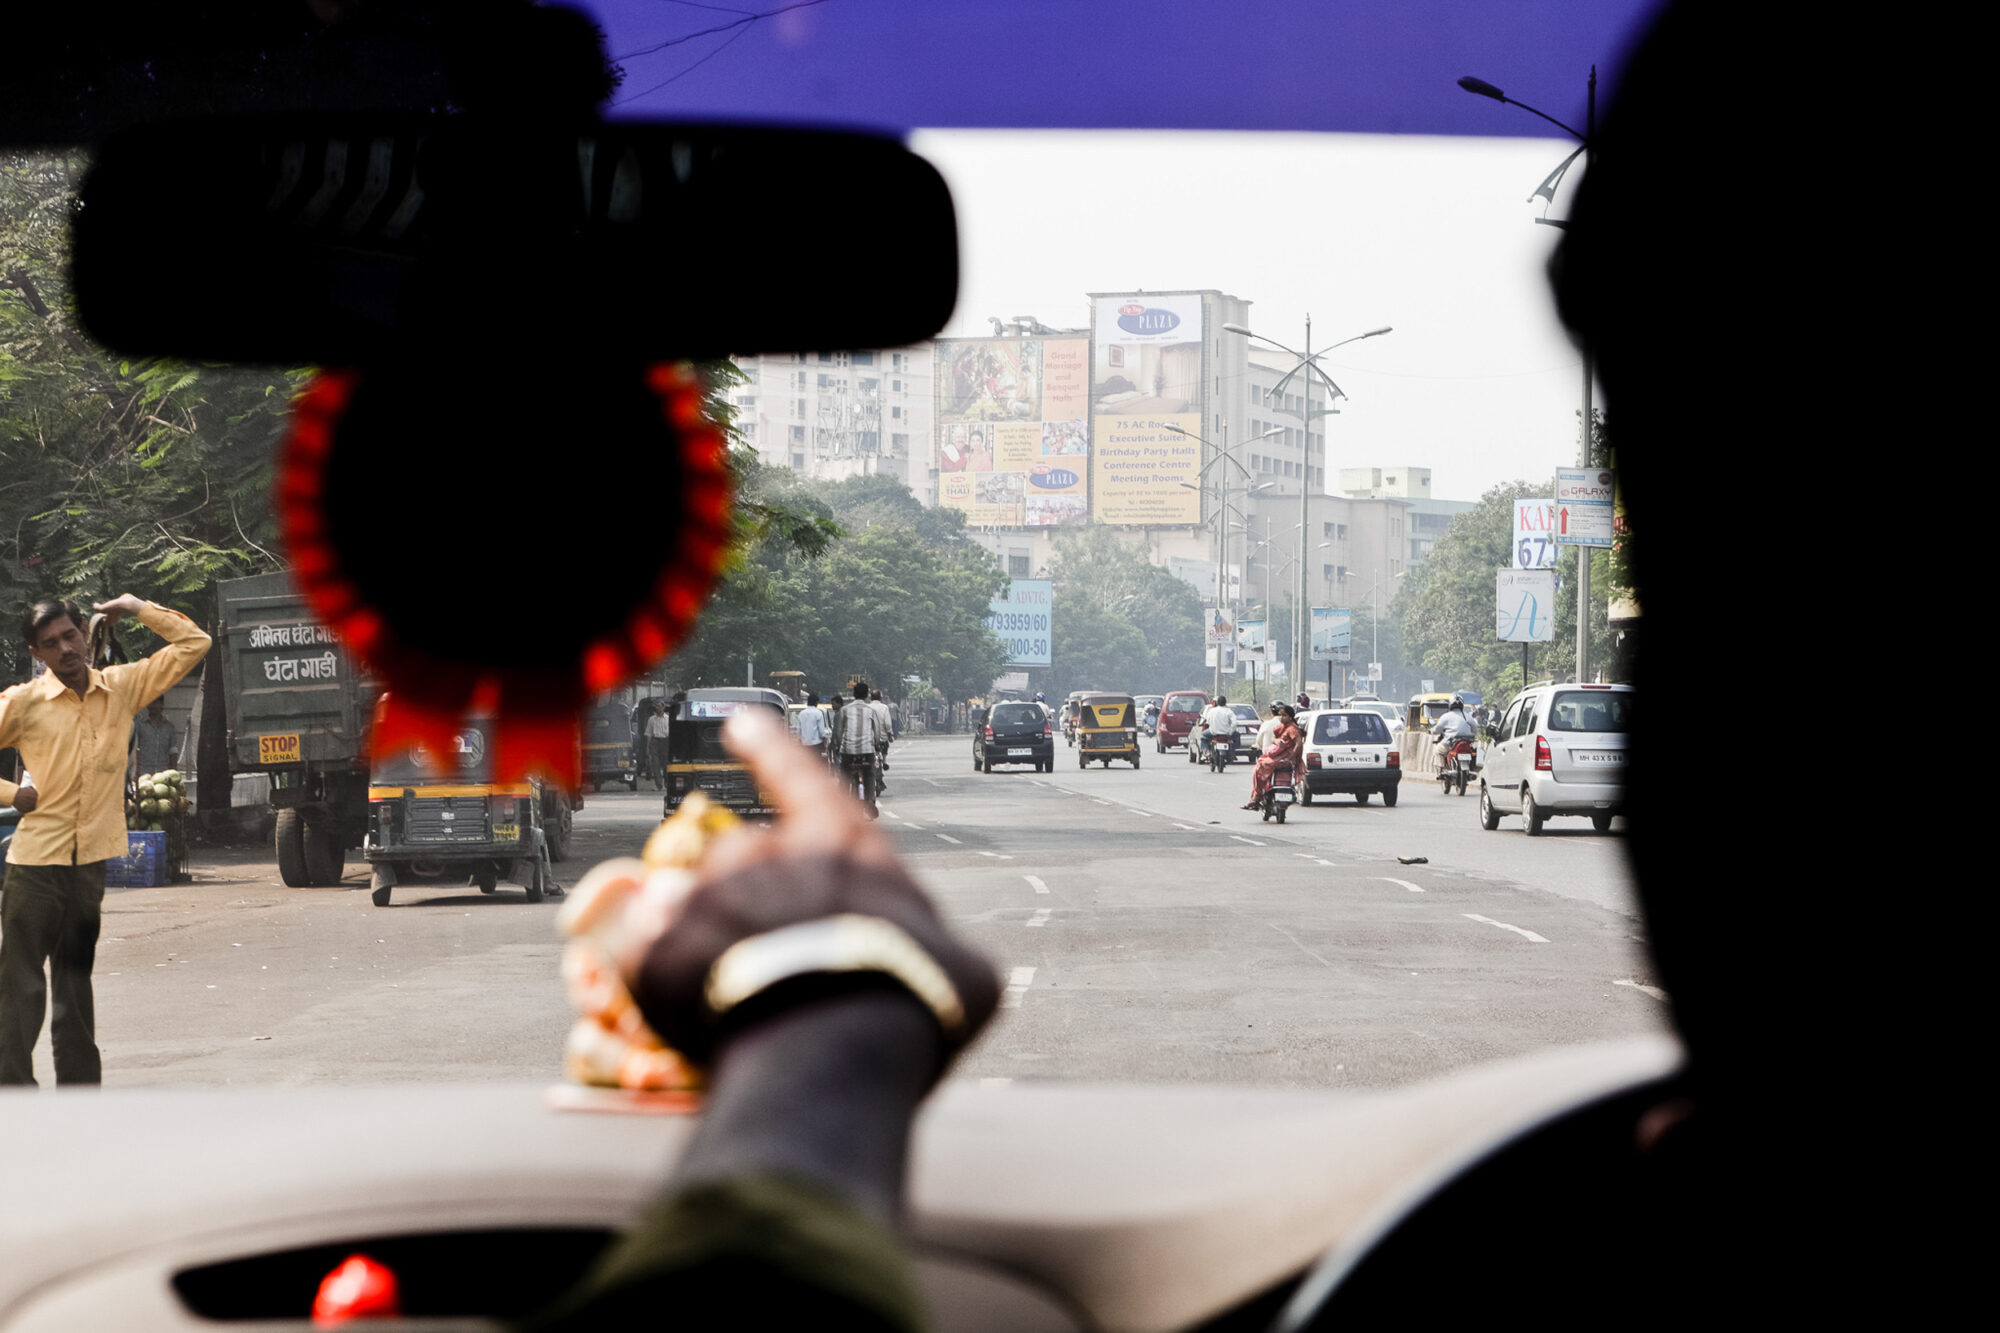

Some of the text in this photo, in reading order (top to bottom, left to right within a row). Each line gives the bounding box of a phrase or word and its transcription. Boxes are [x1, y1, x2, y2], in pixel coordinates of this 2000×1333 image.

[1139, 314, 1173, 329] PLAZA
[1050, 352, 1077, 360] Grand
[1055, 372, 1072, 381] and
[1116, 421, 1128, 429] 75
[1132, 421, 1145, 429] AC
[1109, 434, 1187, 443] Executive Suites
[1100, 447, 1196, 458] Birthday Party Halls
[1103, 461, 1192, 470] Conference Centre
[1046, 472, 1073, 485] PLAZA
[1110, 474, 1184, 485] Meeting Rooms
[1570, 486, 1612, 497] GALAXY
[249, 624, 291, 648] अभिनव
[292, 623, 316, 646] घंटा
[263, 655, 299, 682] घंटा
[300, 650, 338, 678] गाडी
[261, 736, 298, 753] STOP
[263, 753, 298, 763] SIGNAL
